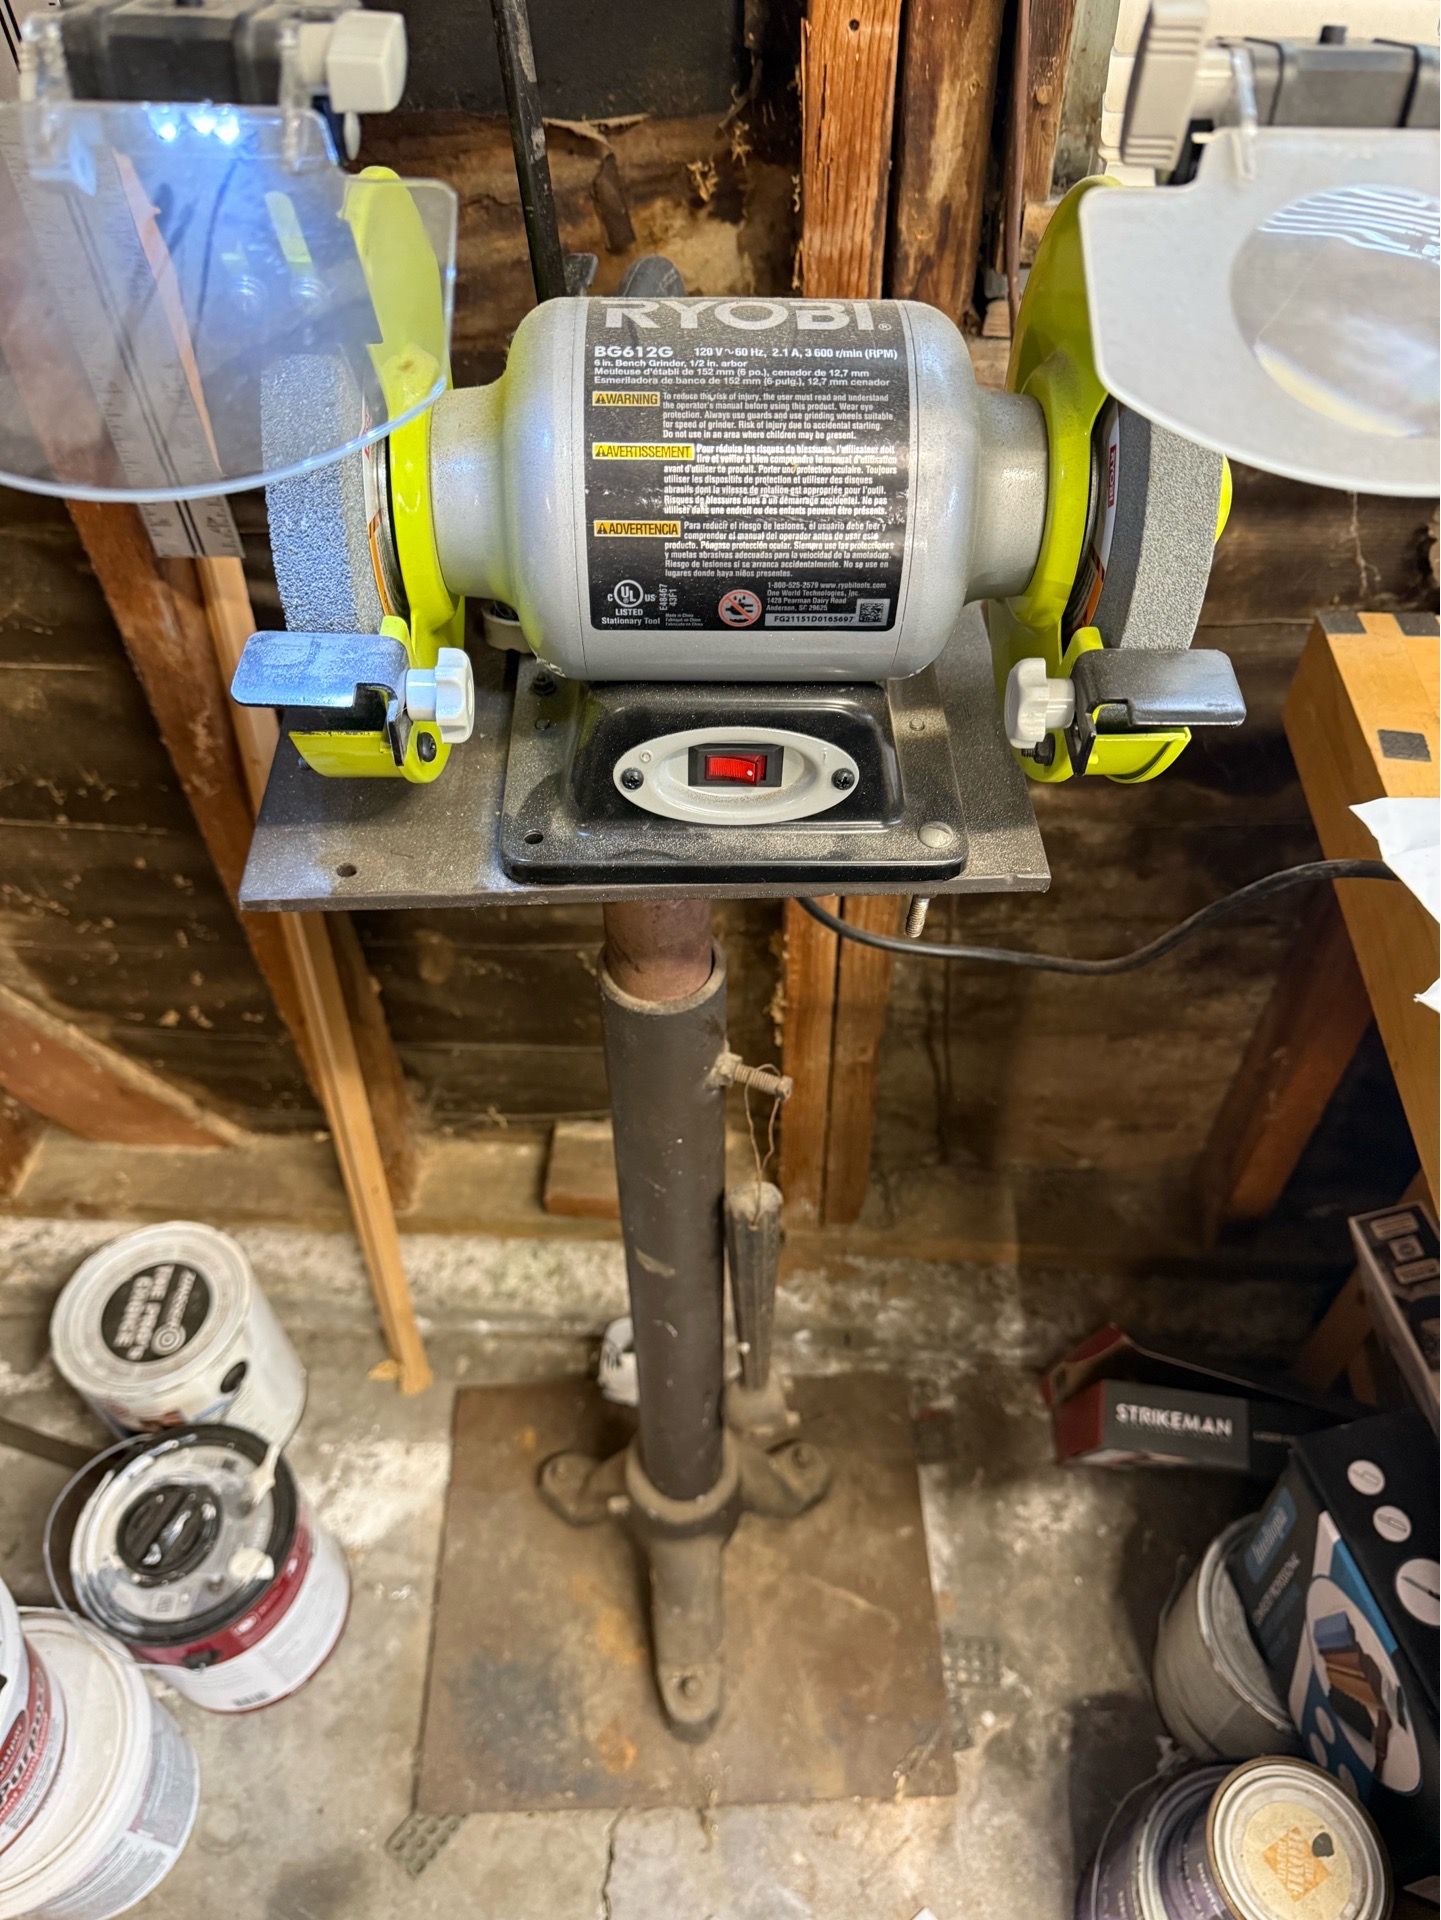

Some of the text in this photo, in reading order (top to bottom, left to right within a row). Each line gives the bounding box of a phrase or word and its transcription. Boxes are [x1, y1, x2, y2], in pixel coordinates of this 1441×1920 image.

[594, 346, 673, 358] BG612G
[694, 347, 714, 356] 120
[772, 347, 789, 357] 2.1
[835, 348, 863, 358] r/min
[865, 349, 898, 360] (RPM)
[648, 359, 687, 367] Grinder,
[594, 367, 641, 375] Meuleuse
[594, 376, 658, 384] Esmeriladora
[661, 376, 673, 384] de
[675, 376, 706, 384] banco
[606, 393, 658, 404] WARNING
[662, 392, 671, 400] To
[673, 392, 698, 400] reduce
[662, 401, 675, 409] the
[715, 402, 743, 410] manual
[744, 402, 768, 410] before
[770, 402, 790, 411] using
[791, 402, 805, 410] this
[704, 411, 730, 420] Always
[804, 412, 835, 420] grinding
[864, 412, 894, 420] suitable
[662, 420, 673, 428] for
[674, 420, 697, 430] speed
[699, 420, 707, 428] of
[756, 421, 764, 429] of
[788, 421, 802, 429] due
[813, 421, 851, 429] accidental
[662, 430, 673, 438] Do
[675, 430, 687, 438] not
[703, 430, 711, 438] in
[798, 432, 813, 440] may
[826, 431, 857, 440] present.
[606, 445, 691, 458] AVERTISSEMENT
[744, 475, 753, 484] de
[754, 475, 791, 485] protection
[829, 475, 843, 484] des
[844, 475, 873, 485] disques
[609, 523, 678, 535] ADVERTENCIA
[664, 559, 690, 569] Riesgo
[691, 560, 700, 568] de
[702, 560, 732, 568] lesiones
[780, 560, 841, 568] accidentalmente.
[843, 560, 853, 568] No
[664, 569, 691, 578] lugares
[693, 569, 715, 577] donde
[716, 570, 734, 578] haya
[756, 570, 793, 578] presentes.
[615, 608, 643, 616] LISTED
[601, 616, 642, 626] Stationary
[1115, 1403, 1233, 1437] STRIKEMAN
